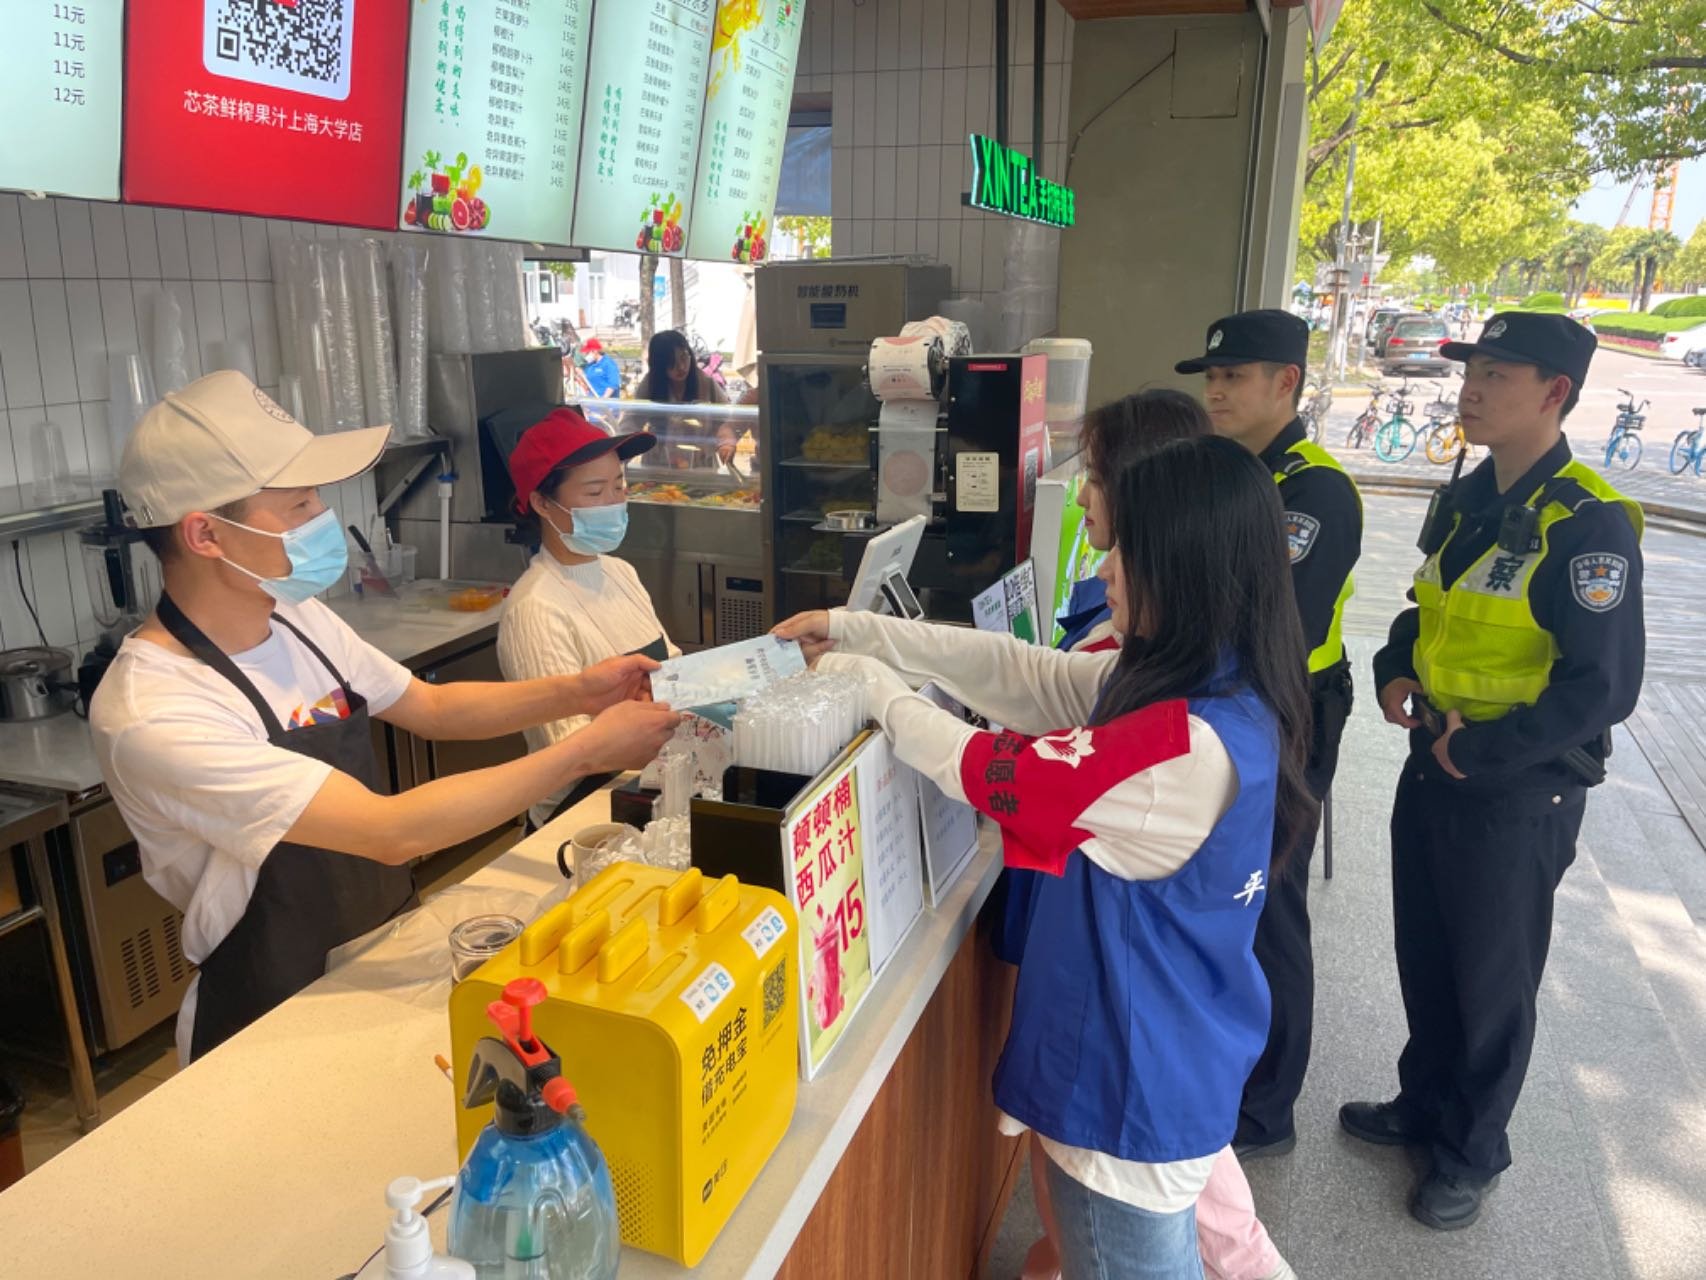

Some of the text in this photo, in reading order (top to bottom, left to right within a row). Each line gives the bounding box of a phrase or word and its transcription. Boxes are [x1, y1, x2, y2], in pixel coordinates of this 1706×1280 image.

[52, 4, 86, 25] 11元
[52, 31, 86, 52] 11元
[53, 59, 86, 79] 11元
[53, 86, 86, 106] 12元
[183, 89, 363, 142] 芯茶鲜榨果汁上海大学店
[981, 134, 1038, 218] XINTEA
[792, 772, 853, 862] 顿顿桶
[796, 819, 857, 911] 西瓜汁
[701, 1007, 748, 1080] 免押金
[701, 1037, 748, 1109] 借充电宝
